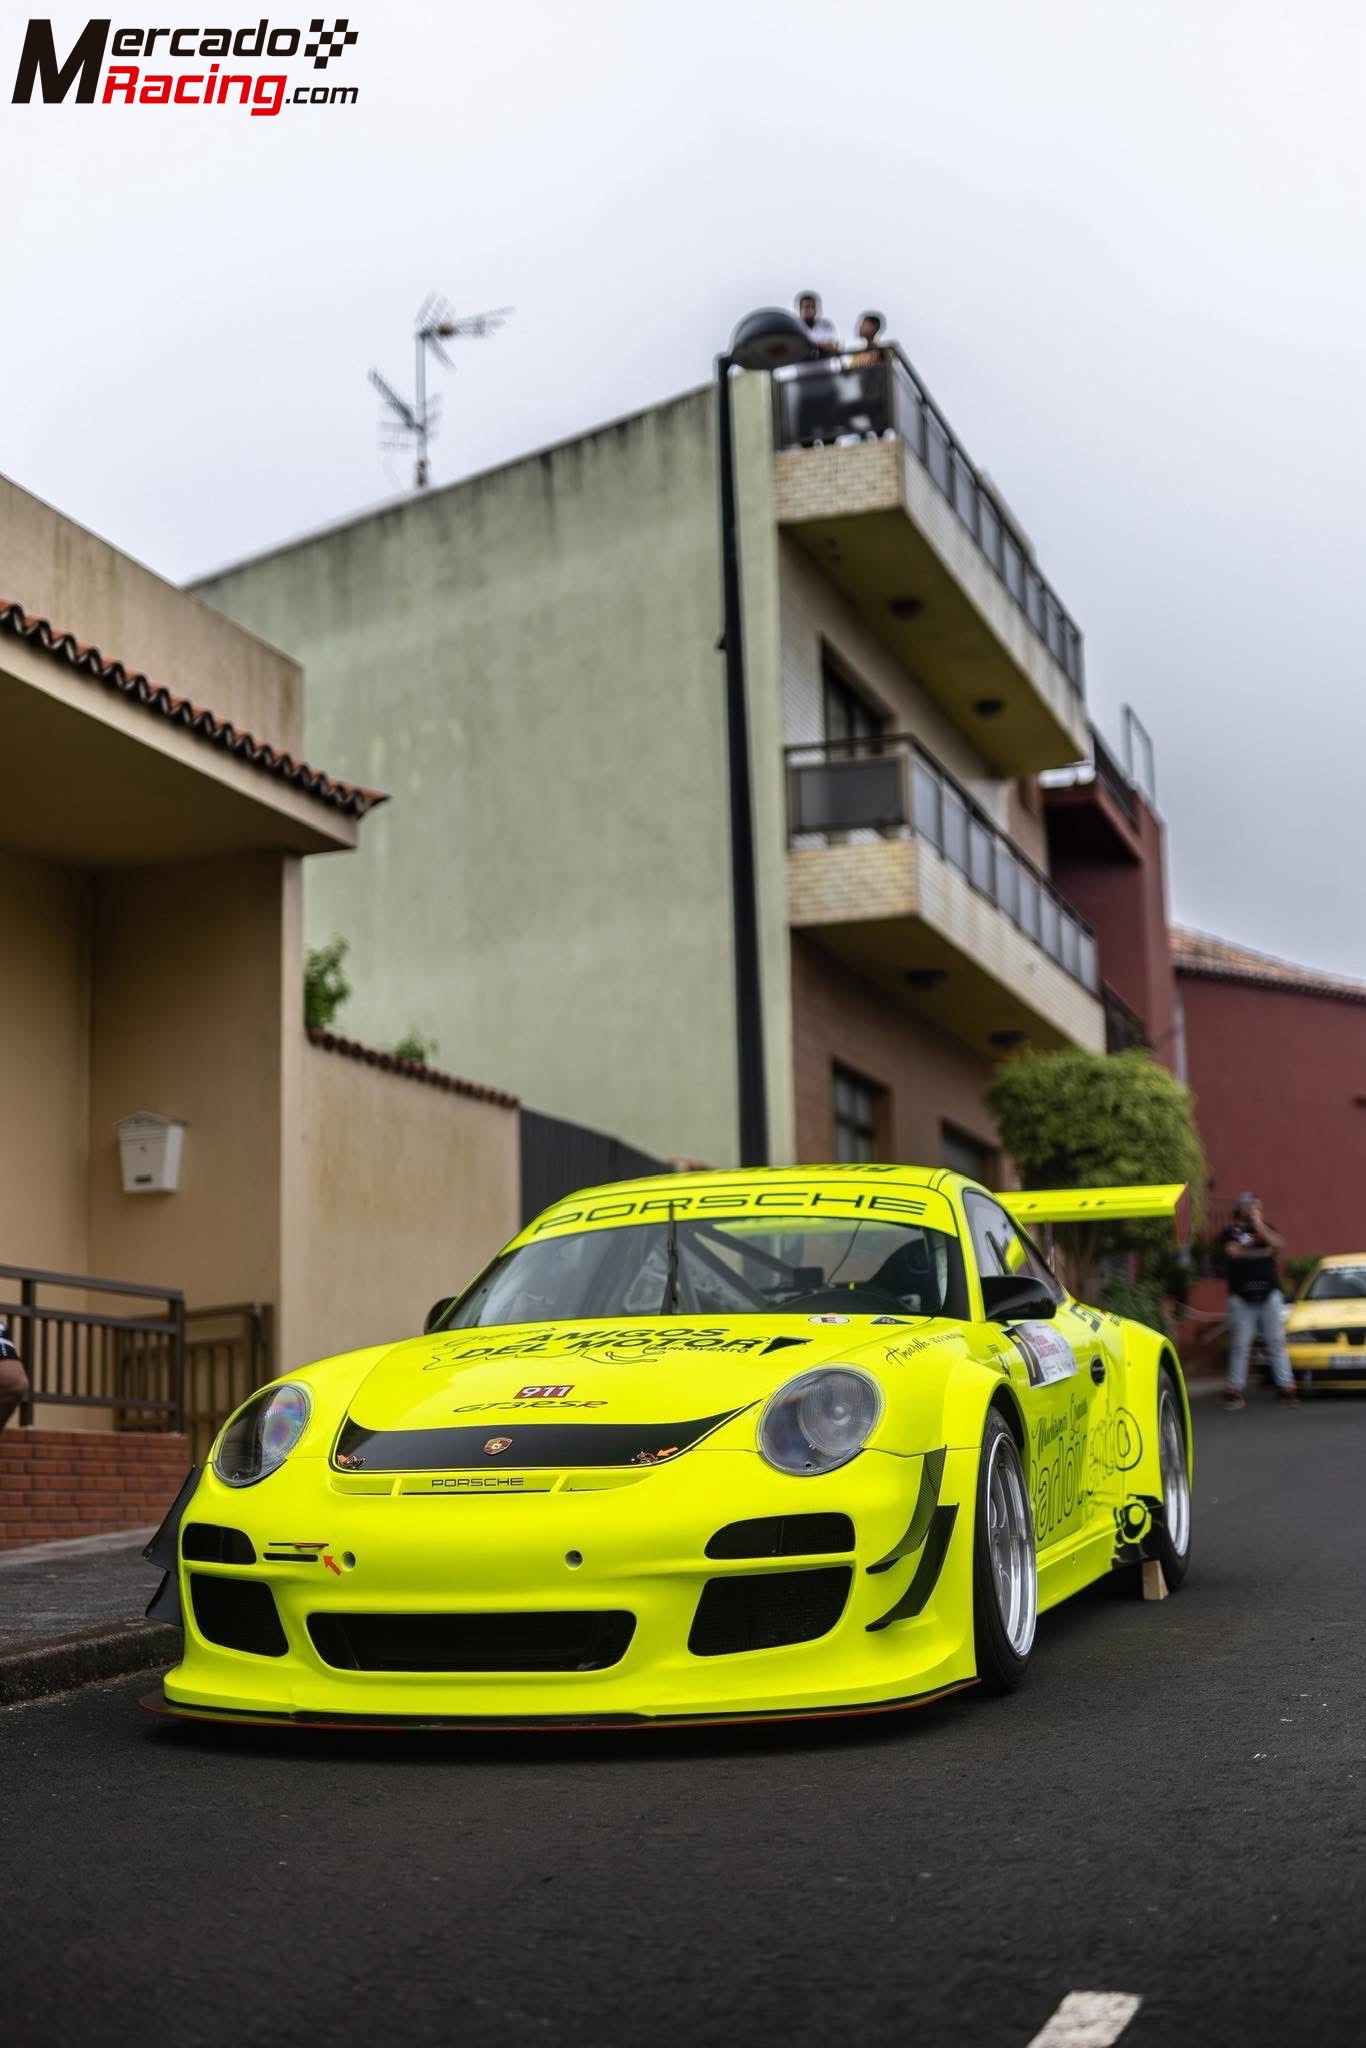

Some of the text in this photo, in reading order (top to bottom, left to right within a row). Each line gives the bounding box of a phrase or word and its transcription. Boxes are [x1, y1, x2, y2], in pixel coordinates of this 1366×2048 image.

[534, 1191, 928, 1234] PORSCHE
[516, 1328, 730, 1344] AMIGOS
[452, 1343, 548, 1360] DEL
[565, 1338, 764, 1350] MOTOR
[521, 1386, 570, 1398] 911
[431, 1477, 524, 1488] PORSCHE
